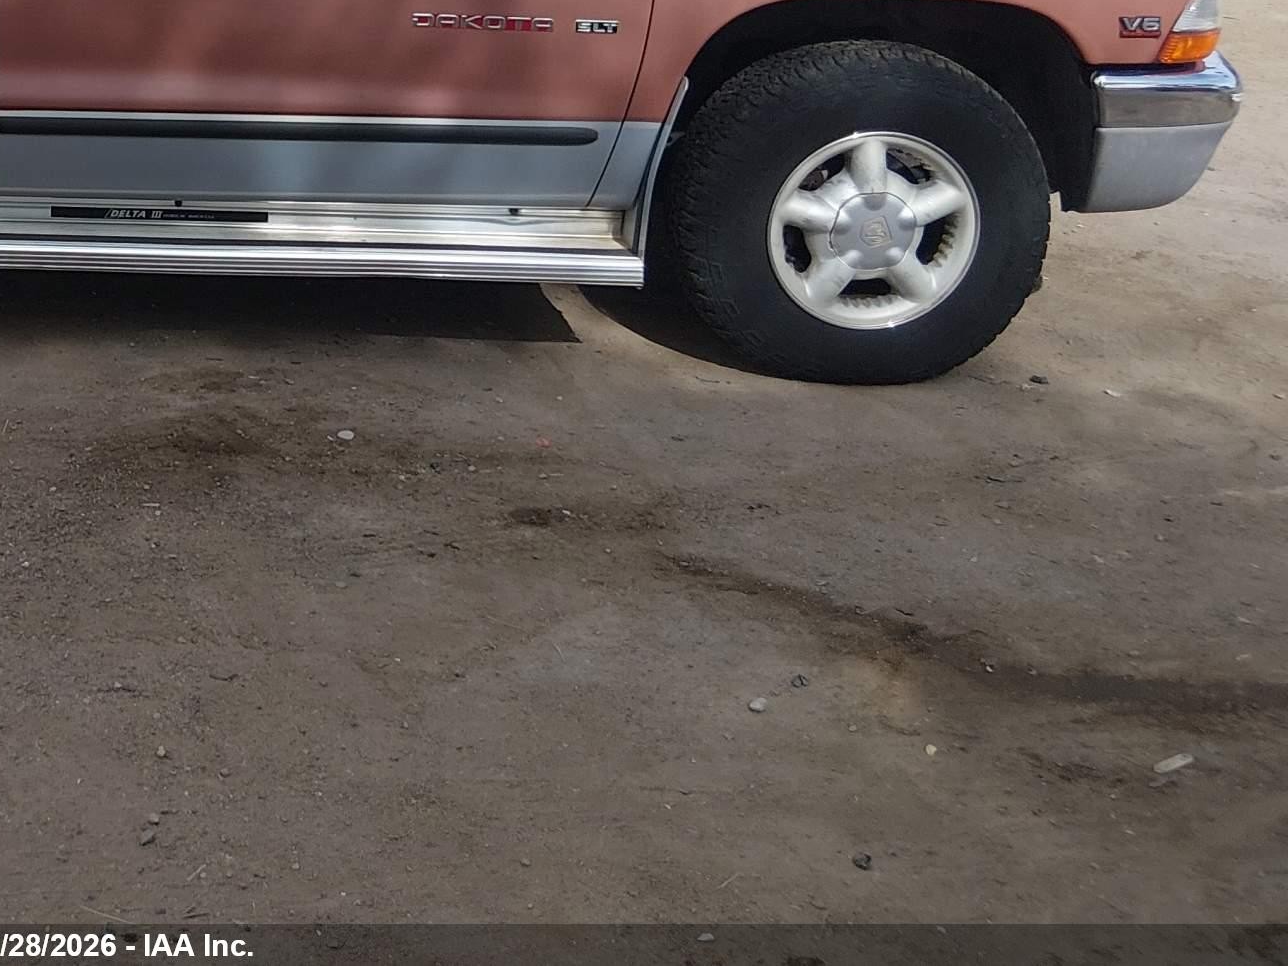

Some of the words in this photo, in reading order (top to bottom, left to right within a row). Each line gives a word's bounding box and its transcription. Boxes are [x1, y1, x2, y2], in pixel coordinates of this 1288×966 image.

[411, 12, 554, 32] DAKOTA
[575, 19, 619, 33] SLT
[1121, 17, 1161, 32] V6
